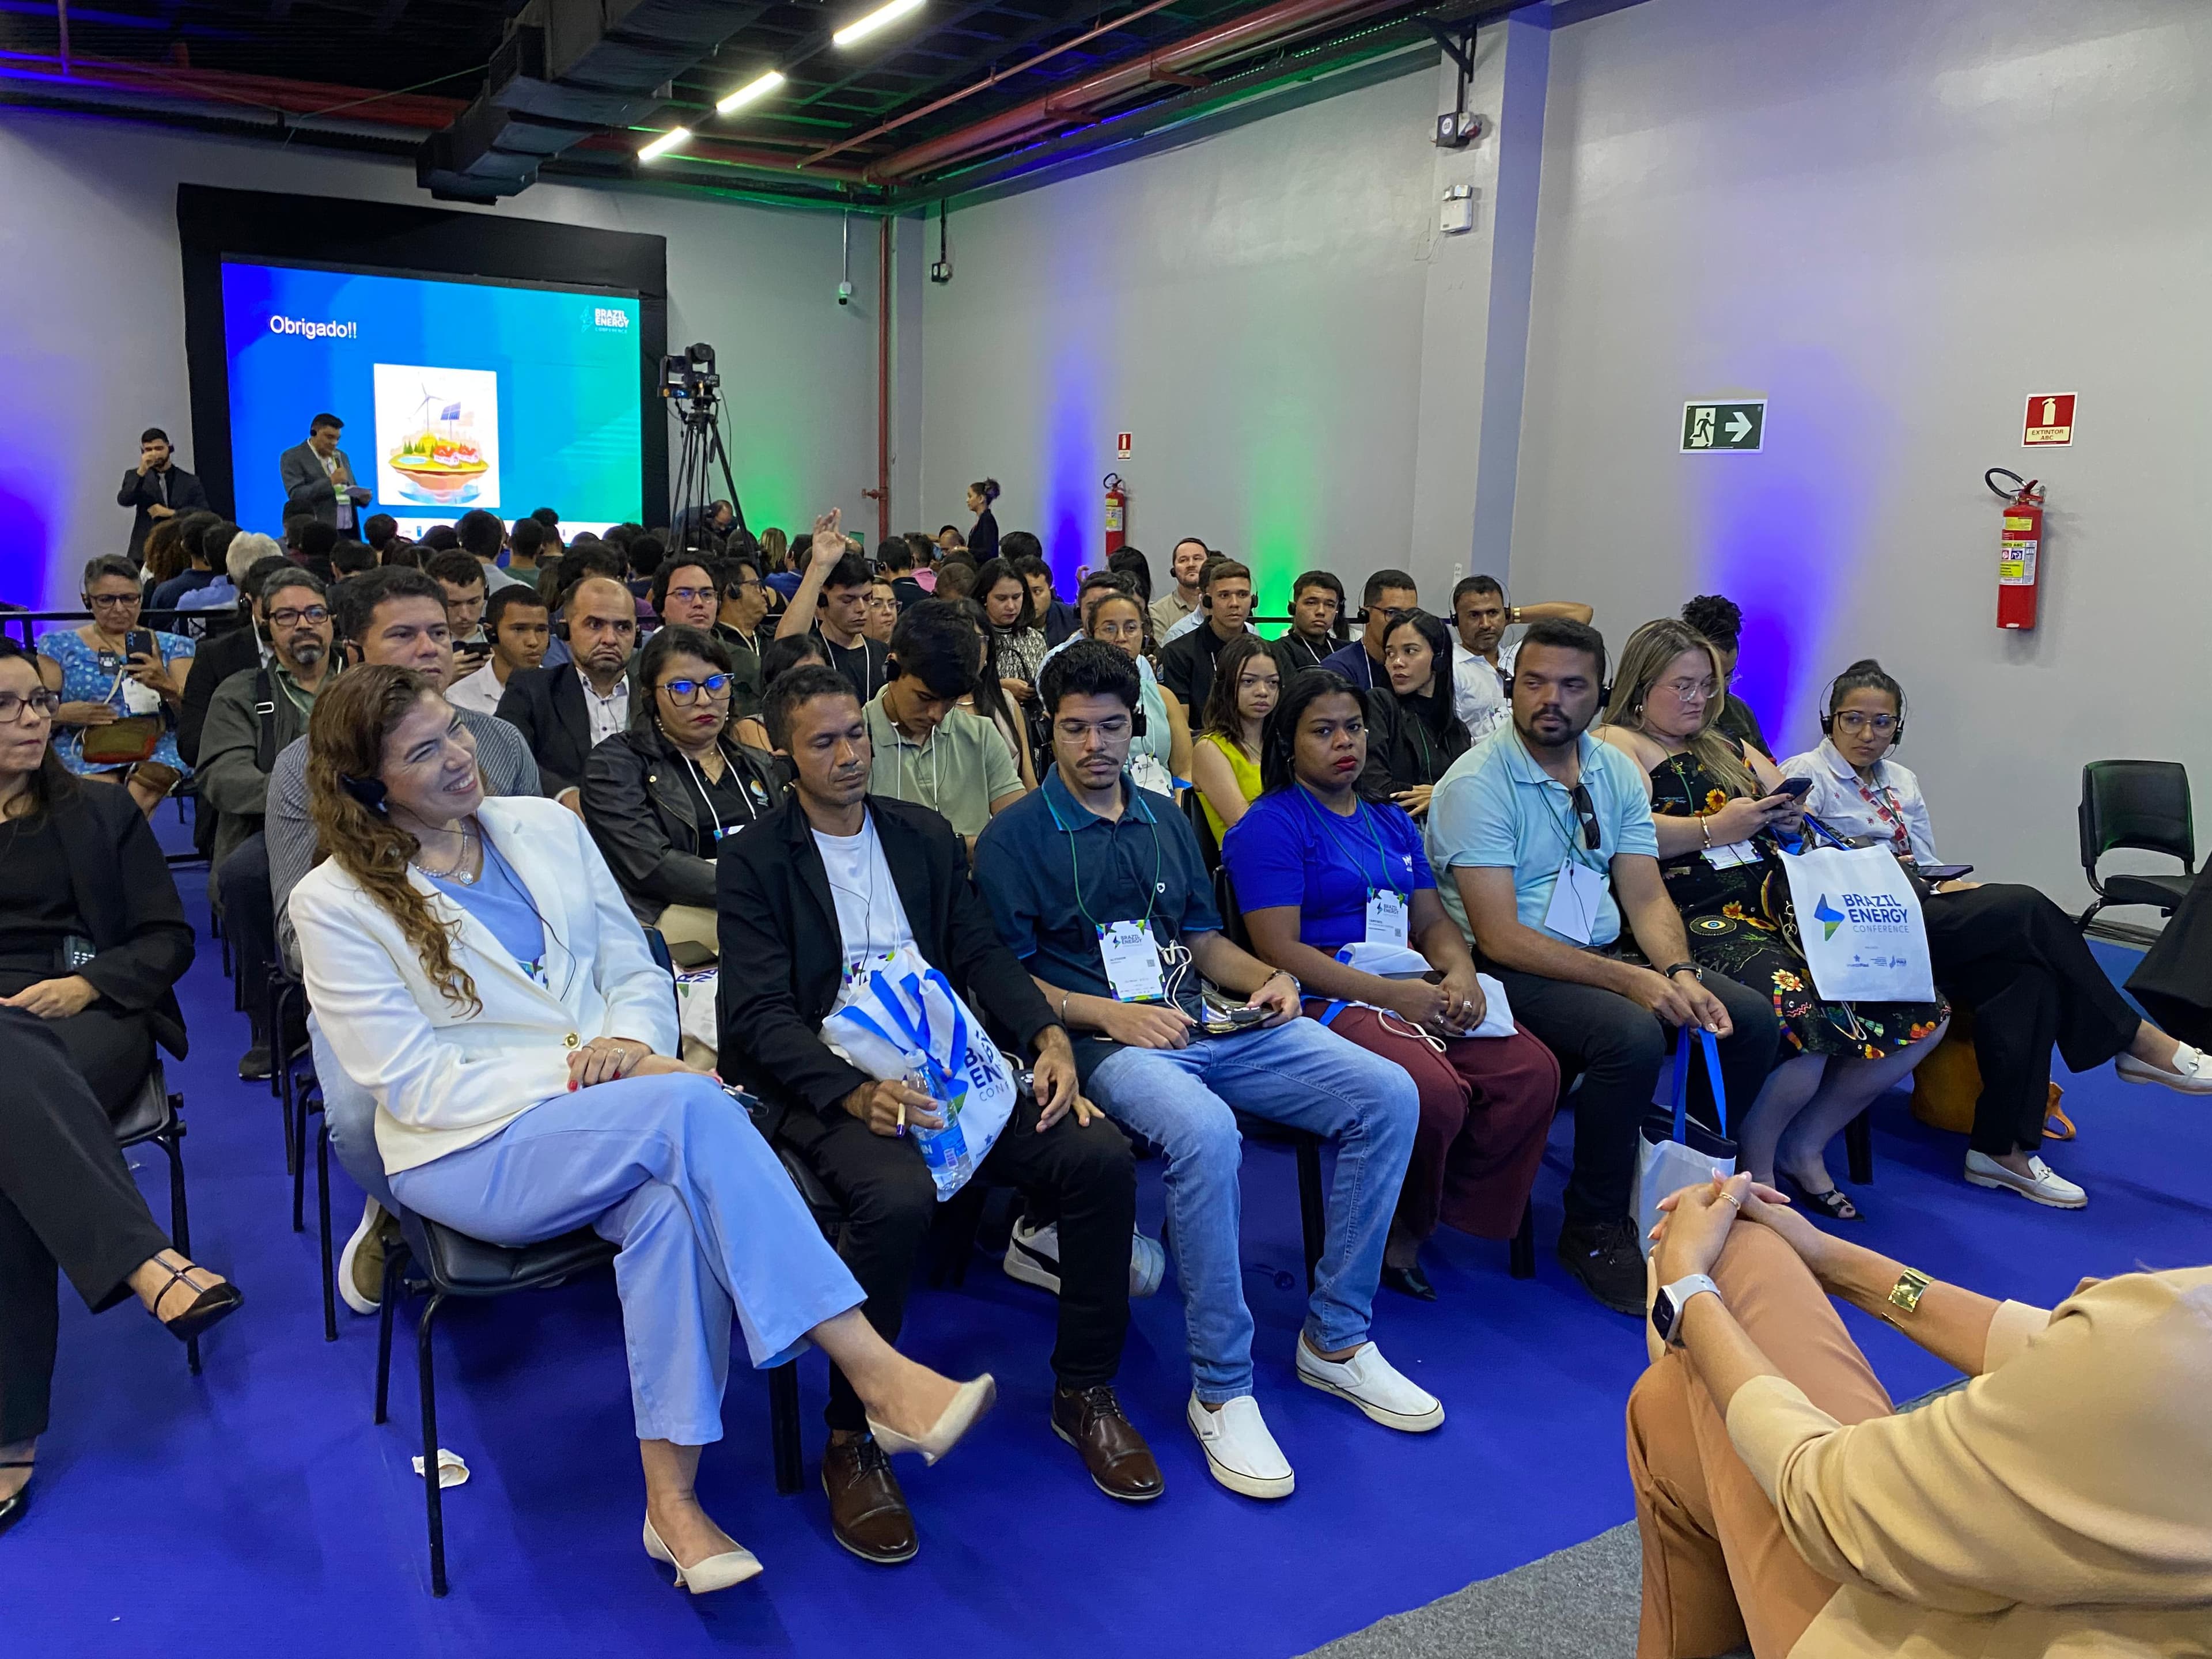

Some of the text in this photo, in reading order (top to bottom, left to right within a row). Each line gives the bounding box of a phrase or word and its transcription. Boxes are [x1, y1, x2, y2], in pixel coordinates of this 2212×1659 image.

[595, 308, 627, 319] BRAZIL
[270, 315, 357, 339] Obrigado!!
[595, 317, 629, 328] ENERGY
[1842, 893, 1902, 907] BRAZIL
[1848, 908, 1907, 923] ENERGY
